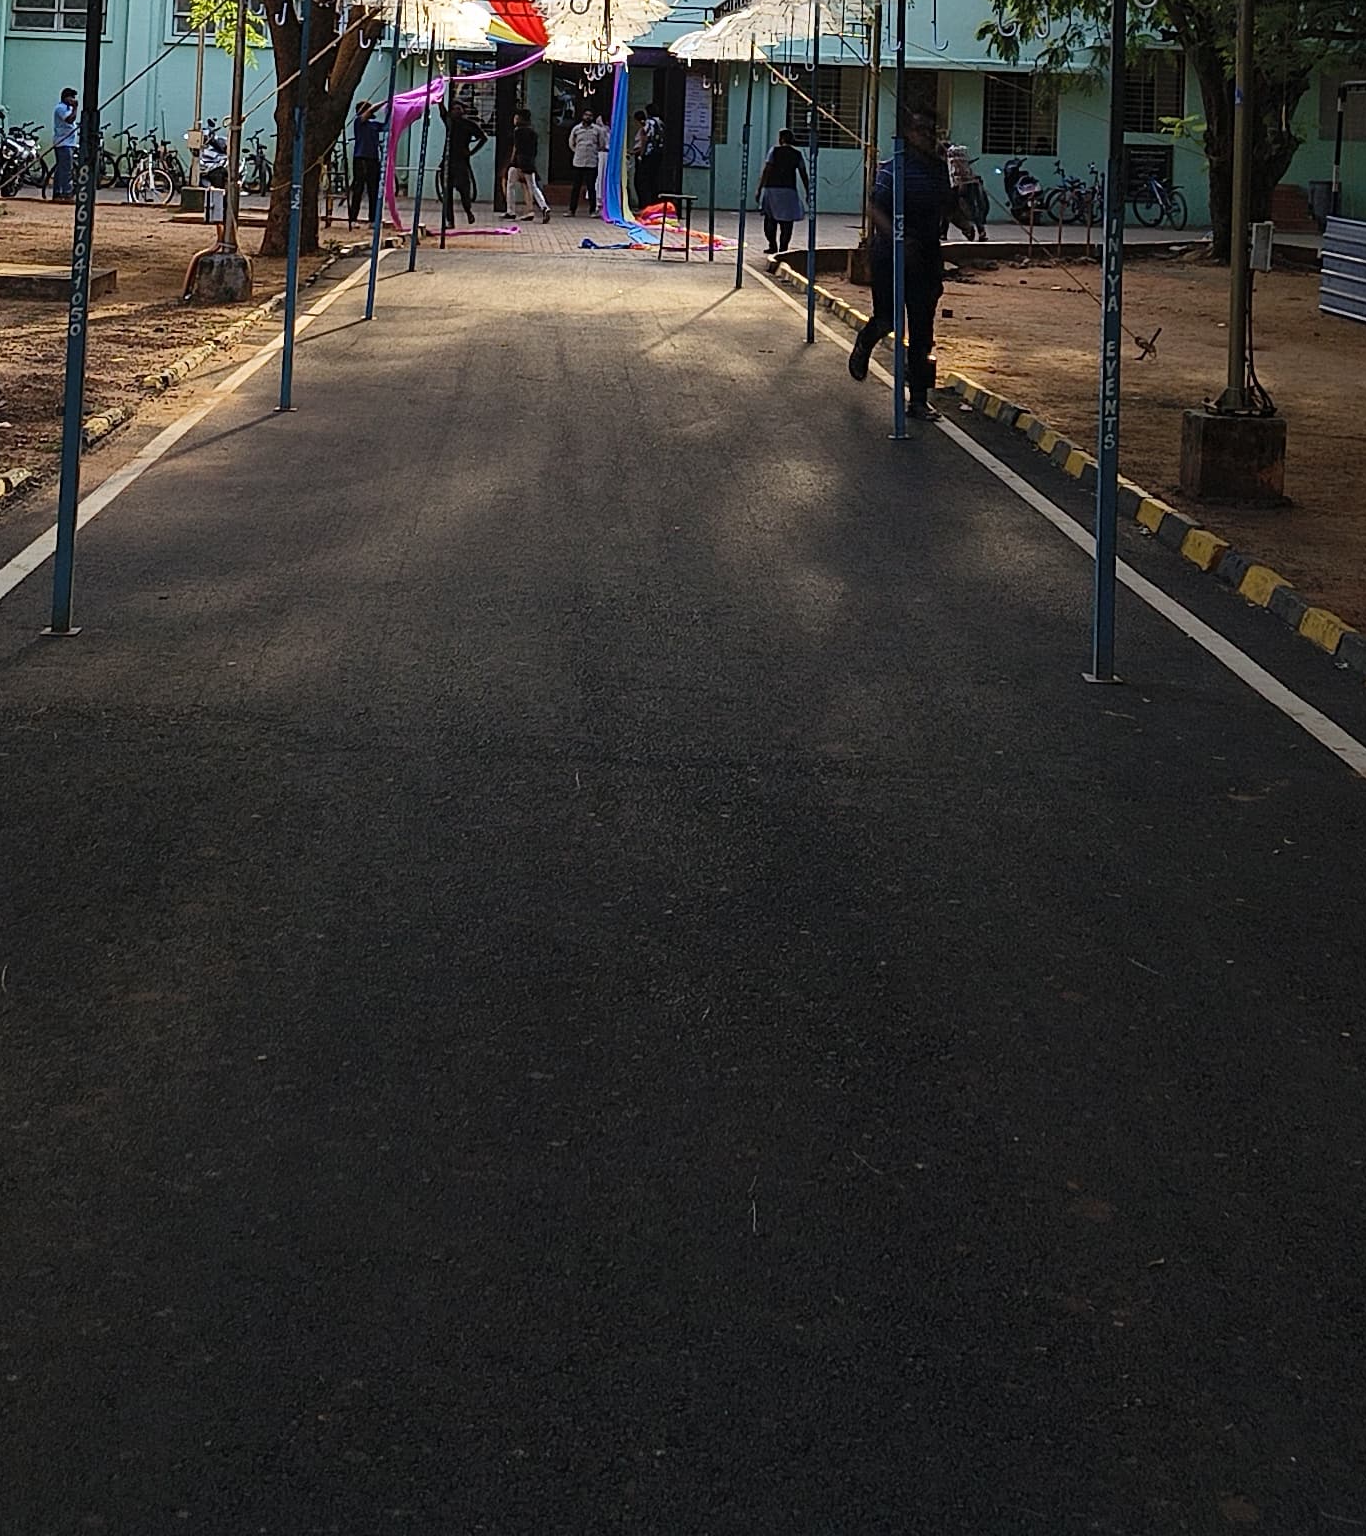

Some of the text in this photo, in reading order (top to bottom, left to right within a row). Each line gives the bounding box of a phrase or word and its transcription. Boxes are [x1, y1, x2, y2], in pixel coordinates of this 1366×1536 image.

[70, 164, 90, 337] 8667041050
[1103, 218, 1120, 450] INIYA EVENTS
